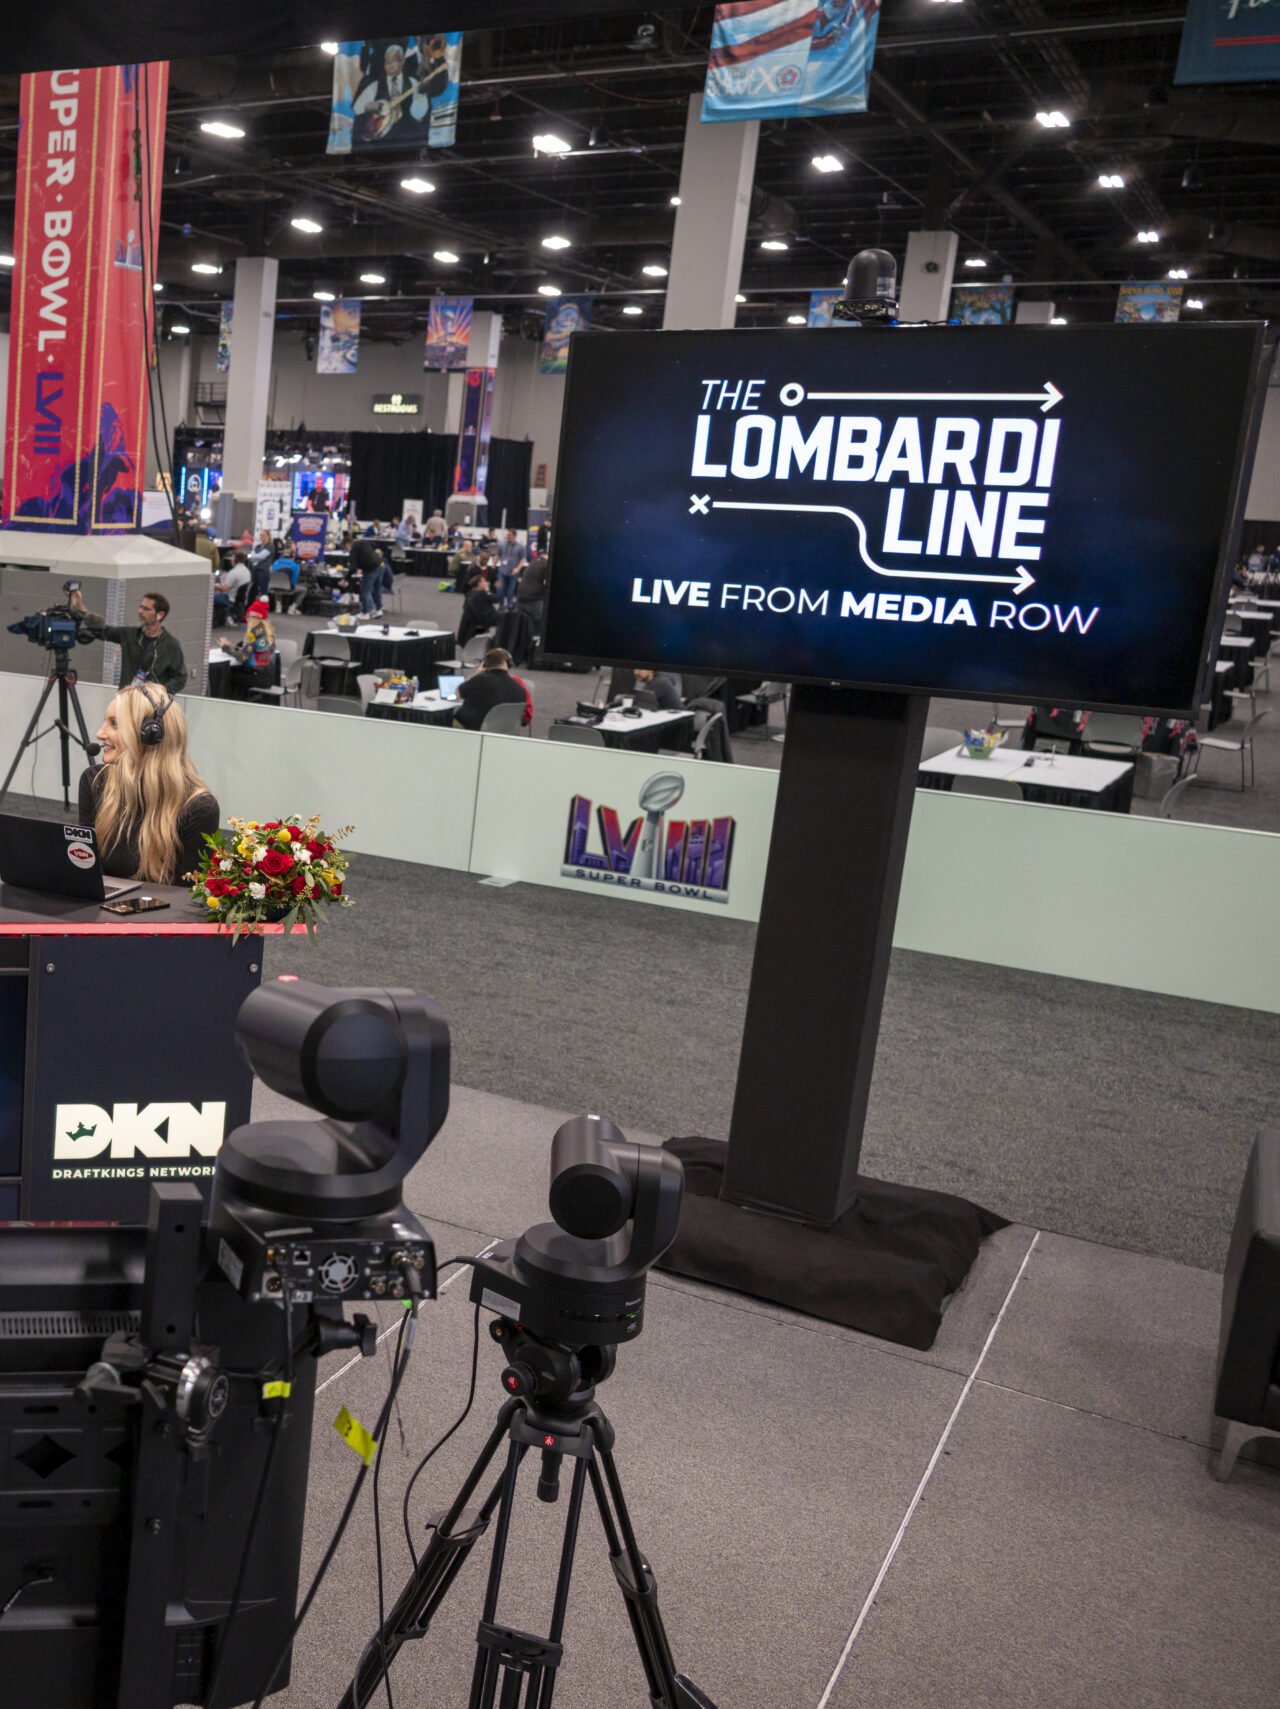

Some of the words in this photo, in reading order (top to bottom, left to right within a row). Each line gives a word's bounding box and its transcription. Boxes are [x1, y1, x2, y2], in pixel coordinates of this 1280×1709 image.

[46, 69, 80, 187] UPER
[38, 211, 73, 352] BOWL
[373, 403, 418, 414] RESTROOMS
[701, 380, 766, 411] THE
[691, 414, 1062, 488] LOMBARDI
[882, 488, 1050, 561] LINE
[631, 578, 712, 608] LIVE
[720, 583, 830, 616] FROM
[840, 591, 978, 627] MEDIA
[989, 600, 1100, 634] ROW
[575, 869, 642, 888] SUPER
[654, 882, 714, 900] BOWL
[53, 1101, 227, 1160] DKN
[52, 1167, 145, 1179] DRAFTKINGS
